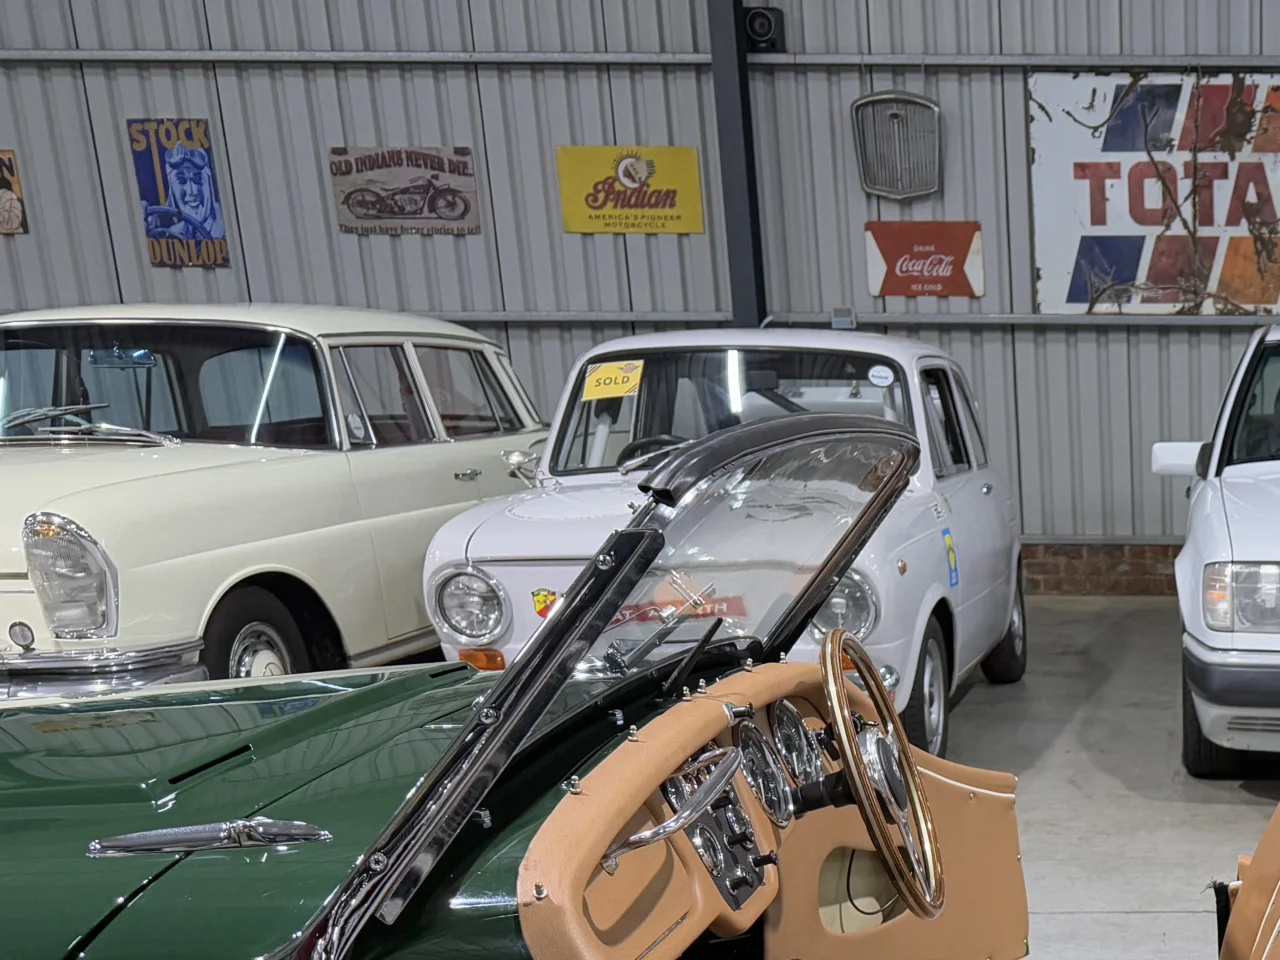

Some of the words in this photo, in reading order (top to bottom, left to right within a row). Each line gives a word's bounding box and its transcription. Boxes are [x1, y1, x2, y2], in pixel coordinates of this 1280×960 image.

[130, 120, 209, 152] STOCK
[330, 159, 353, 177] OLD
[355, 150, 402, 173] INDIANS
[405, 150, 446, 173] NEVER
[584, 175, 678, 211] Indian
[150, 238, 229, 265] DUNLOP
[895, 254, 955, 277] Coca-Cola
[594, 375, 630, 387] SOLD
